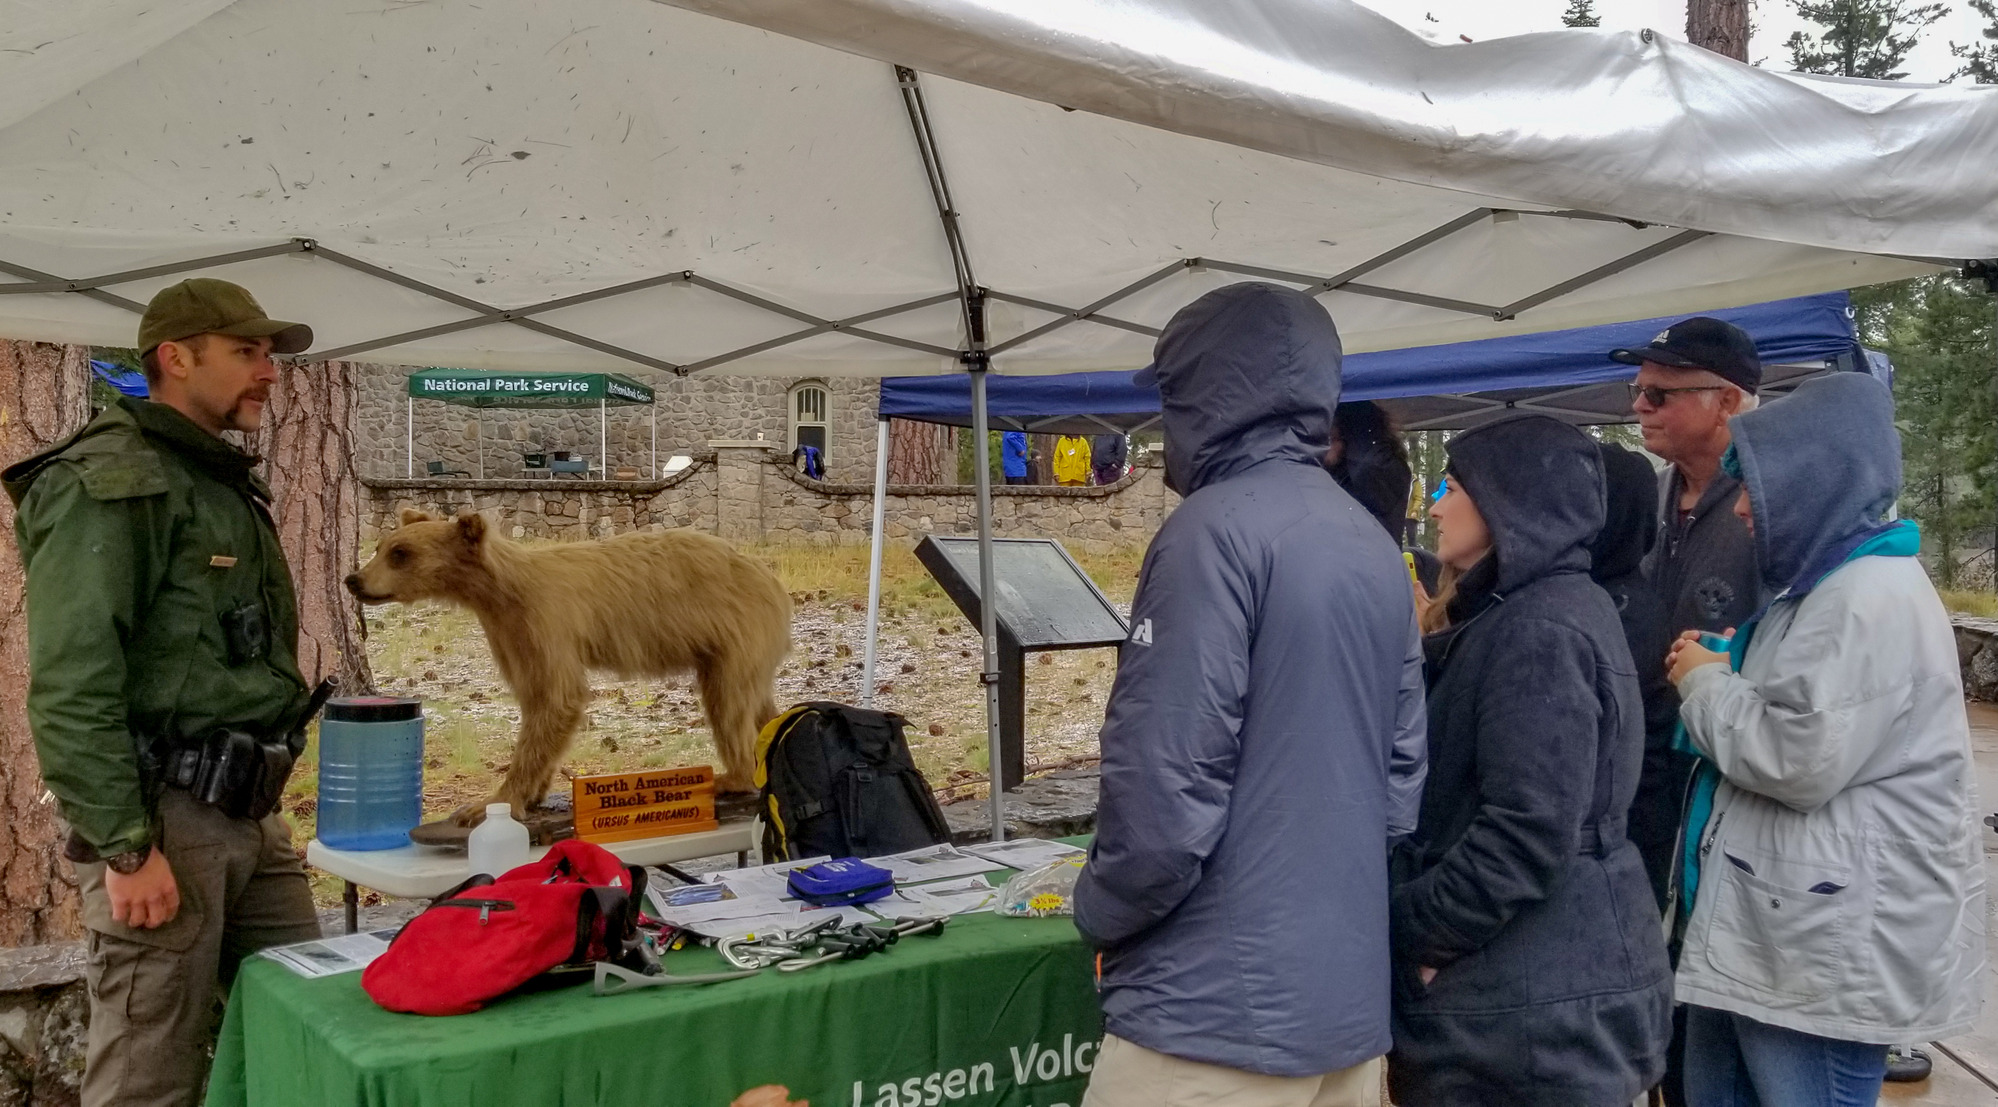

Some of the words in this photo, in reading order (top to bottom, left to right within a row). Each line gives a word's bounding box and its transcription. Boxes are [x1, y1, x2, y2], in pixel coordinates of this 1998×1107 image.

[424, 378, 490, 392] National
[496, 378, 529, 391] Park
[533, 379, 589, 392] Service
[585, 779, 628, 795] North
[634, 774, 704, 790] American
[600, 793, 647, 809] Black
[654, 789, 692, 804] Bear
[592, 815, 629, 830] (URSUS
[635, 805, 700, 824] AMERICANUS)
[1010, 1033, 1100, 1085] Volc
